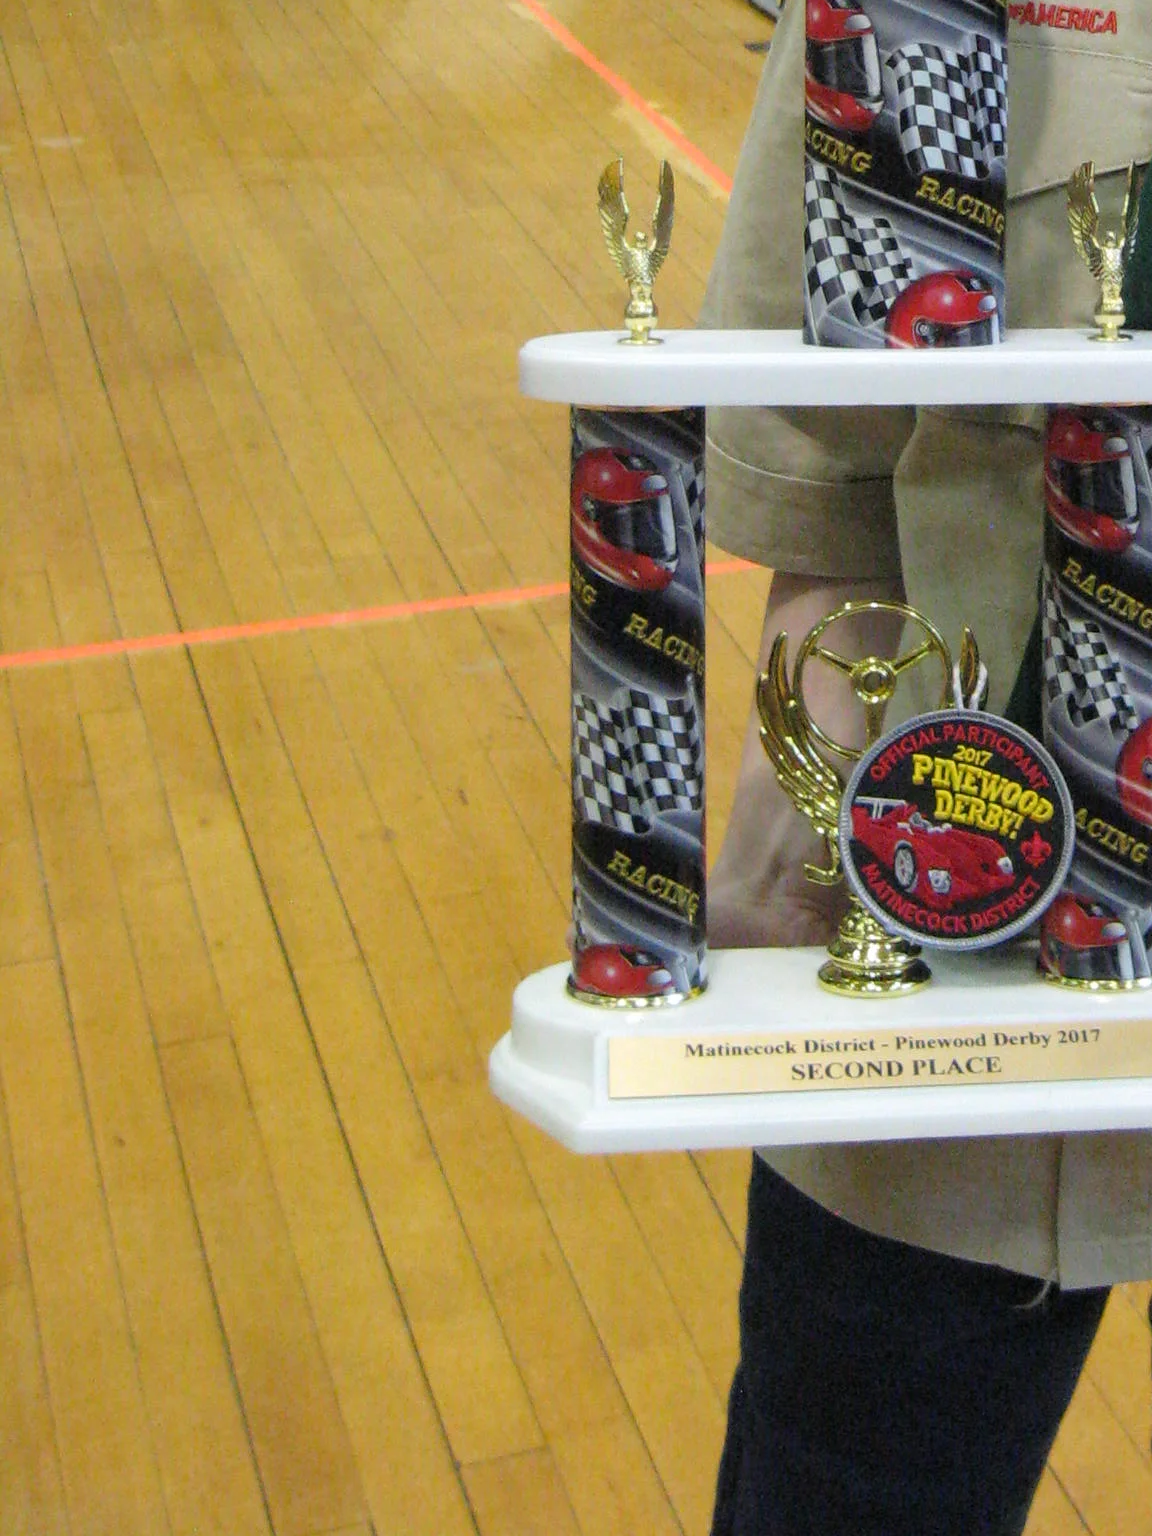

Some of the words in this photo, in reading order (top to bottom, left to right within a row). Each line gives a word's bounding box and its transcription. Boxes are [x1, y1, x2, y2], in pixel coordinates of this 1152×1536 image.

[1020, 0, 1118, 34] AMERICA
[915, 175, 1005, 234] RACING
[870, 727, 939, 782] OFFICIAL
[943, 722, 1050, 790] PARTICIPANT
[953, 744, 994, 766] 2017
[912, 753, 1054, 824] PINEWOOD
[934, 789, 1025, 840] DERBY!
[861, 864, 968, 934] MATINECOCK
[971, 875, 1041, 931] DISTRICT
[684, 1042, 797, 1058] Matinecock
[804, 1038, 875, 1054] District
[895, 1033, 987, 1051] Pinewood
[993, 1031, 1051, 1049] Derby
[1057, 1028, 1102, 1044] 2017
[791, 1060, 904, 1081] SECOND
[913, 1056, 1003, 1076] PLACE
